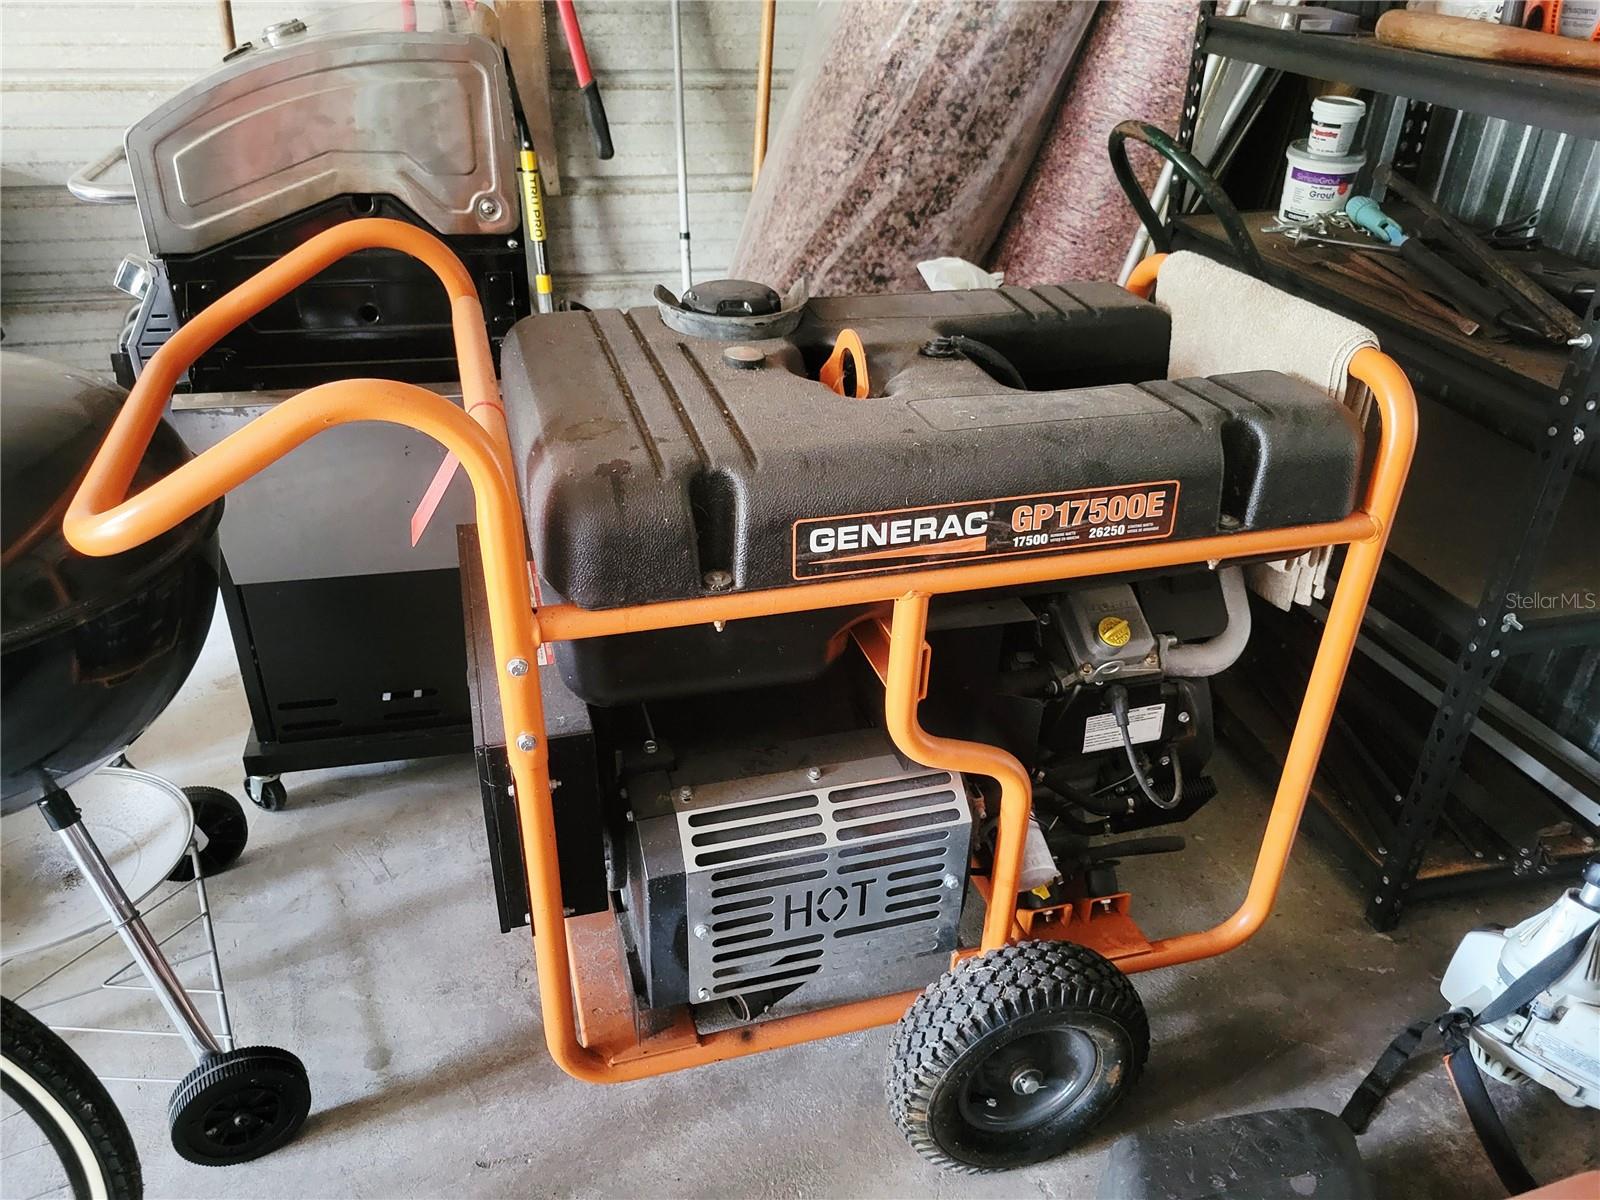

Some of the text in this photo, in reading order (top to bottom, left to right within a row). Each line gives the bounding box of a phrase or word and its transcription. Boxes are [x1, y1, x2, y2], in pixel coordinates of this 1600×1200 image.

[1309, 190, 1335, 199] Grout
[533, 209, 543, 238] PRO
[1011, 491, 1166, 533] GP17500E
[810, 511, 989, 553] GENERAC
[1012, 533, 1049, 548] 17500
[1088, 524, 1126, 539] 26250
[784, 878, 877, 931] HOT
